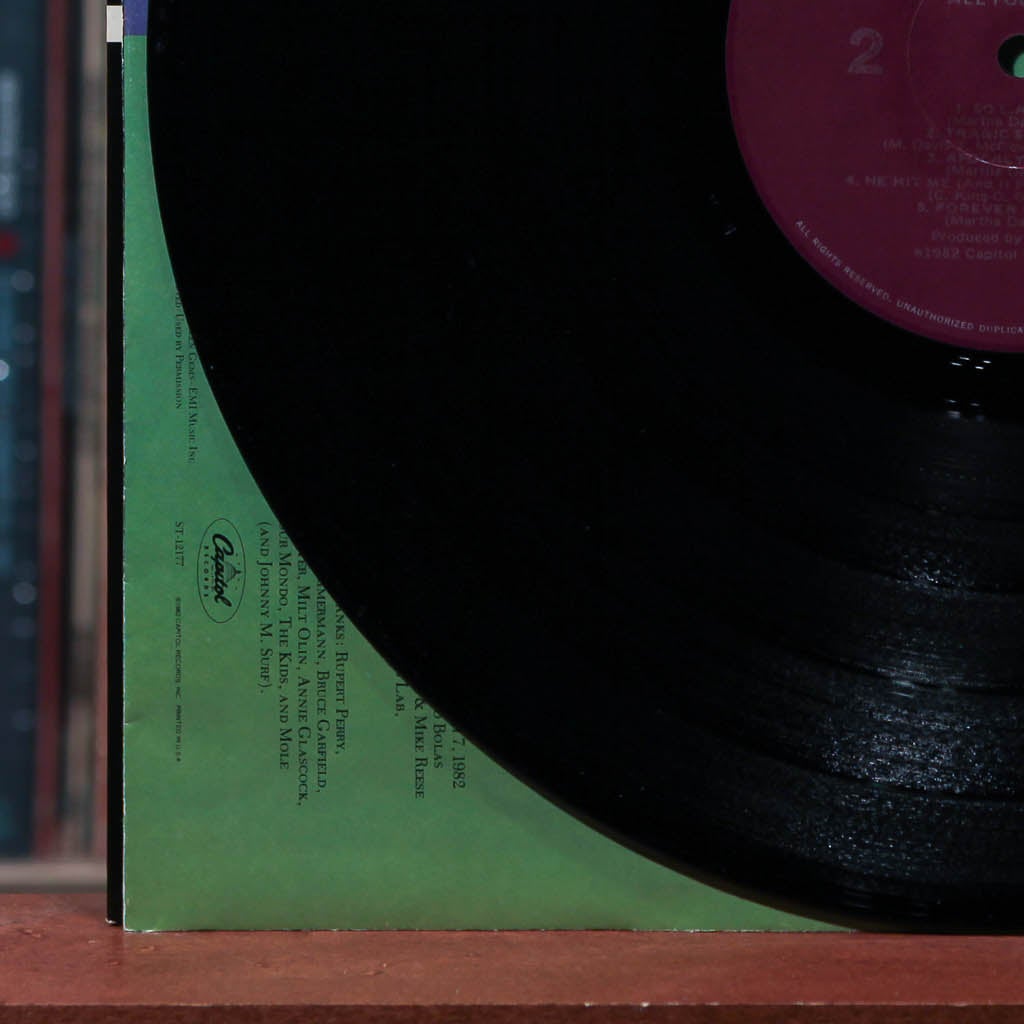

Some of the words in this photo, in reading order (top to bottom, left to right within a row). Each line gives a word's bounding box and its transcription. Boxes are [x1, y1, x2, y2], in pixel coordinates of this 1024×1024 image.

[848, 28, 884, 74] 2
[812, 238, 841, 268] RIGHTS
[897, 300, 974, 330] UNAUTHORIZED
[211, 534, 235, 607] Capitol
[256, 560, 273, 618] JOHNNY
[298, 586, 310, 623] MILT
[279, 617, 292, 647] THE
[298, 676, 310, 722] ANNIE
[317, 671, 330, 715] BRUCE
[336, 651, 348, 704] RUPERT
[280, 695, 288, 723] AND
[280, 728, 292, 769] MOLE
[415, 716, 427, 752] MIKE
[433, 724, 446, 768] BOLAS
[415, 758, 428, 798] REESE
[452, 756, 465, 788] 1982
